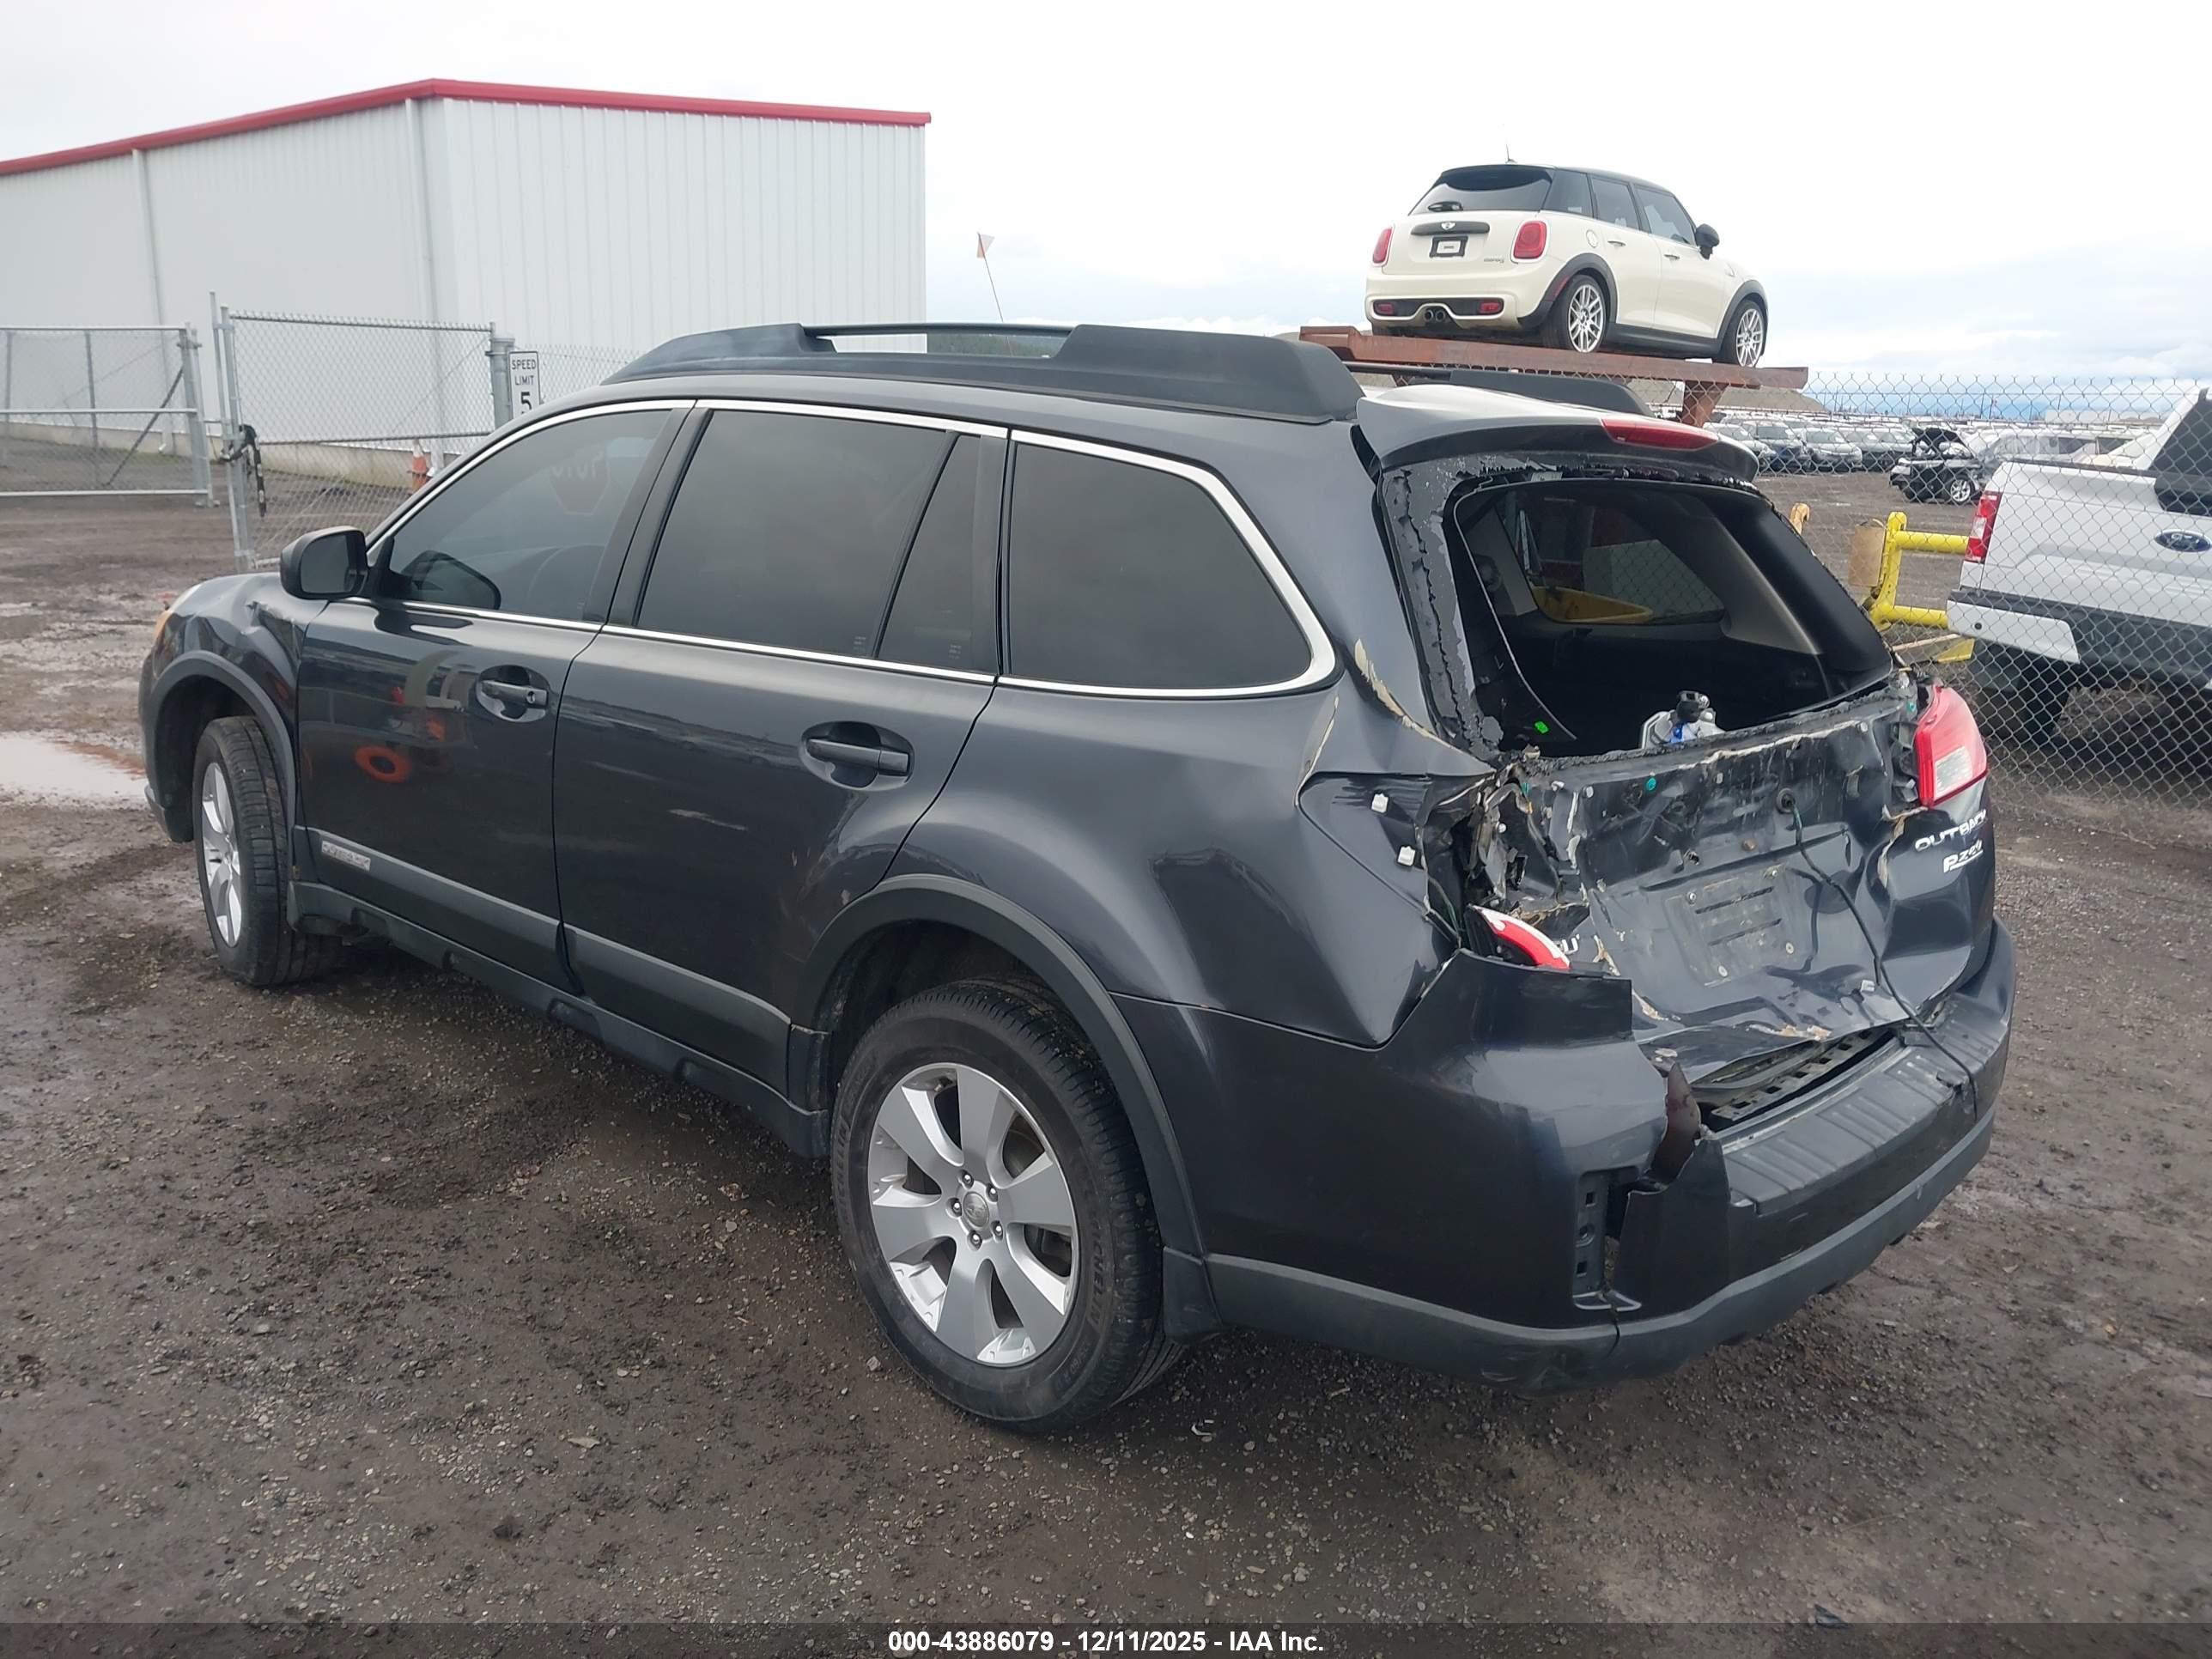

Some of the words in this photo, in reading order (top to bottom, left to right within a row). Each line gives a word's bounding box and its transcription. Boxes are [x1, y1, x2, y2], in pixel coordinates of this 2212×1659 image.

[511, 359, 537, 370] SPEED
[514, 375, 534, 386] LIMIT
[520, 391, 532, 414] 5
